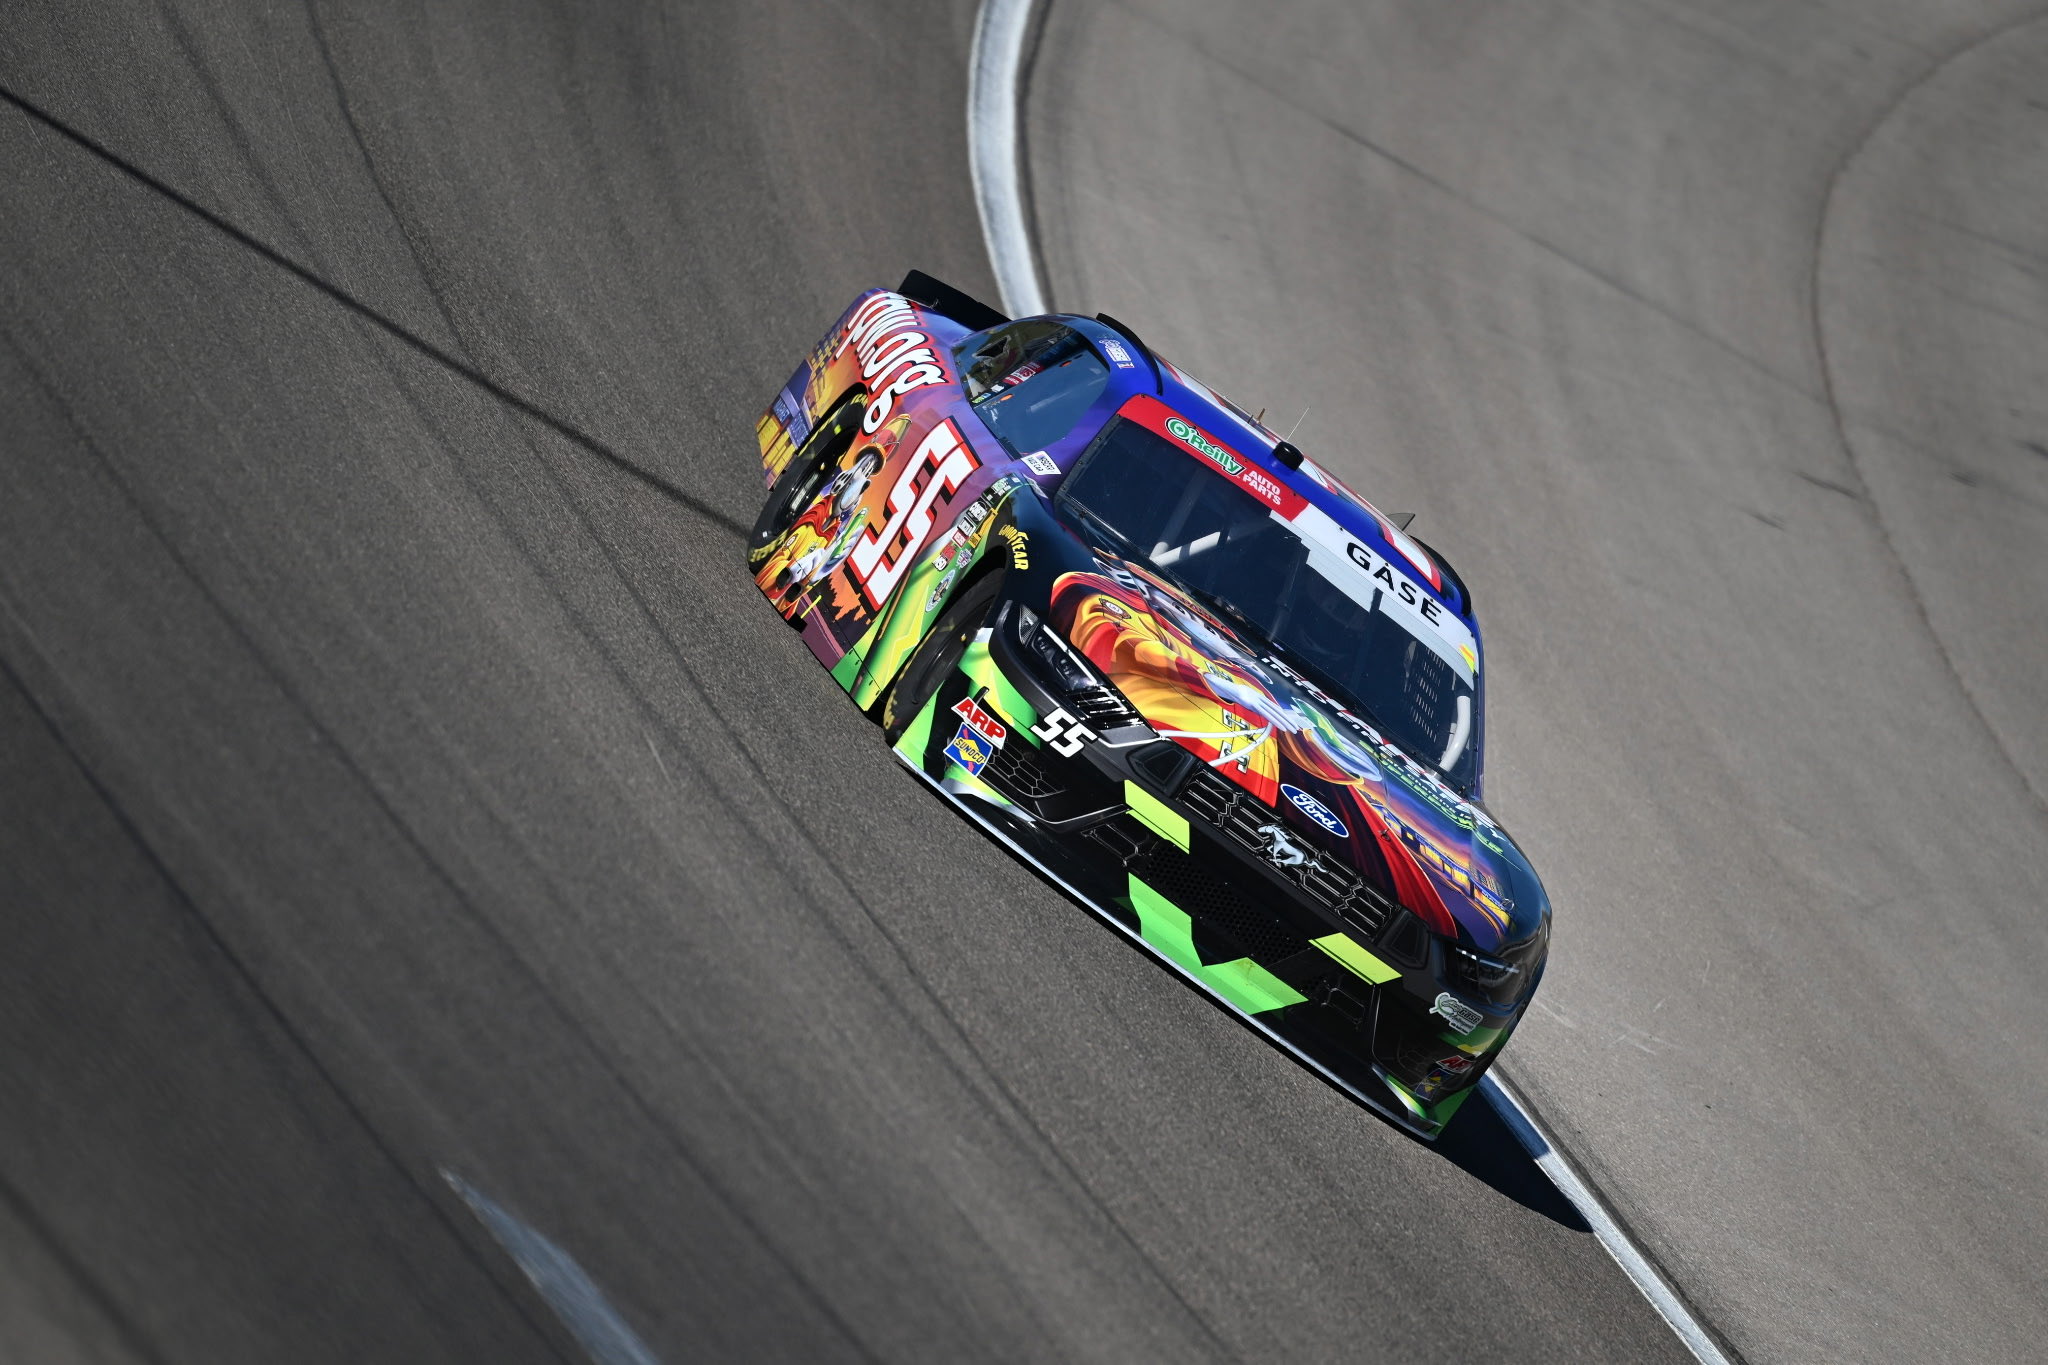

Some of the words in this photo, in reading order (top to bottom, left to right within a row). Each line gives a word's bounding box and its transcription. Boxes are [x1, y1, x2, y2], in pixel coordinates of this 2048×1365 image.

[1165, 417, 1244, 475] O'Reilly
[1242, 474, 1281, 505] PARTS
[1248, 470, 1281, 496] AUTO
[843, 415, 983, 616] 55
[998, 524, 1029, 570] GOODYEAR
[1346, 541, 1442, 628] GASE
[1261, 657, 1327, 704] INTO
[956, 698, 1006, 739] ARP
[1030, 707, 1099, 758] 55
[955, 739, 984, 764] SUNOCO
[1292, 793, 1338, 829] Ford
